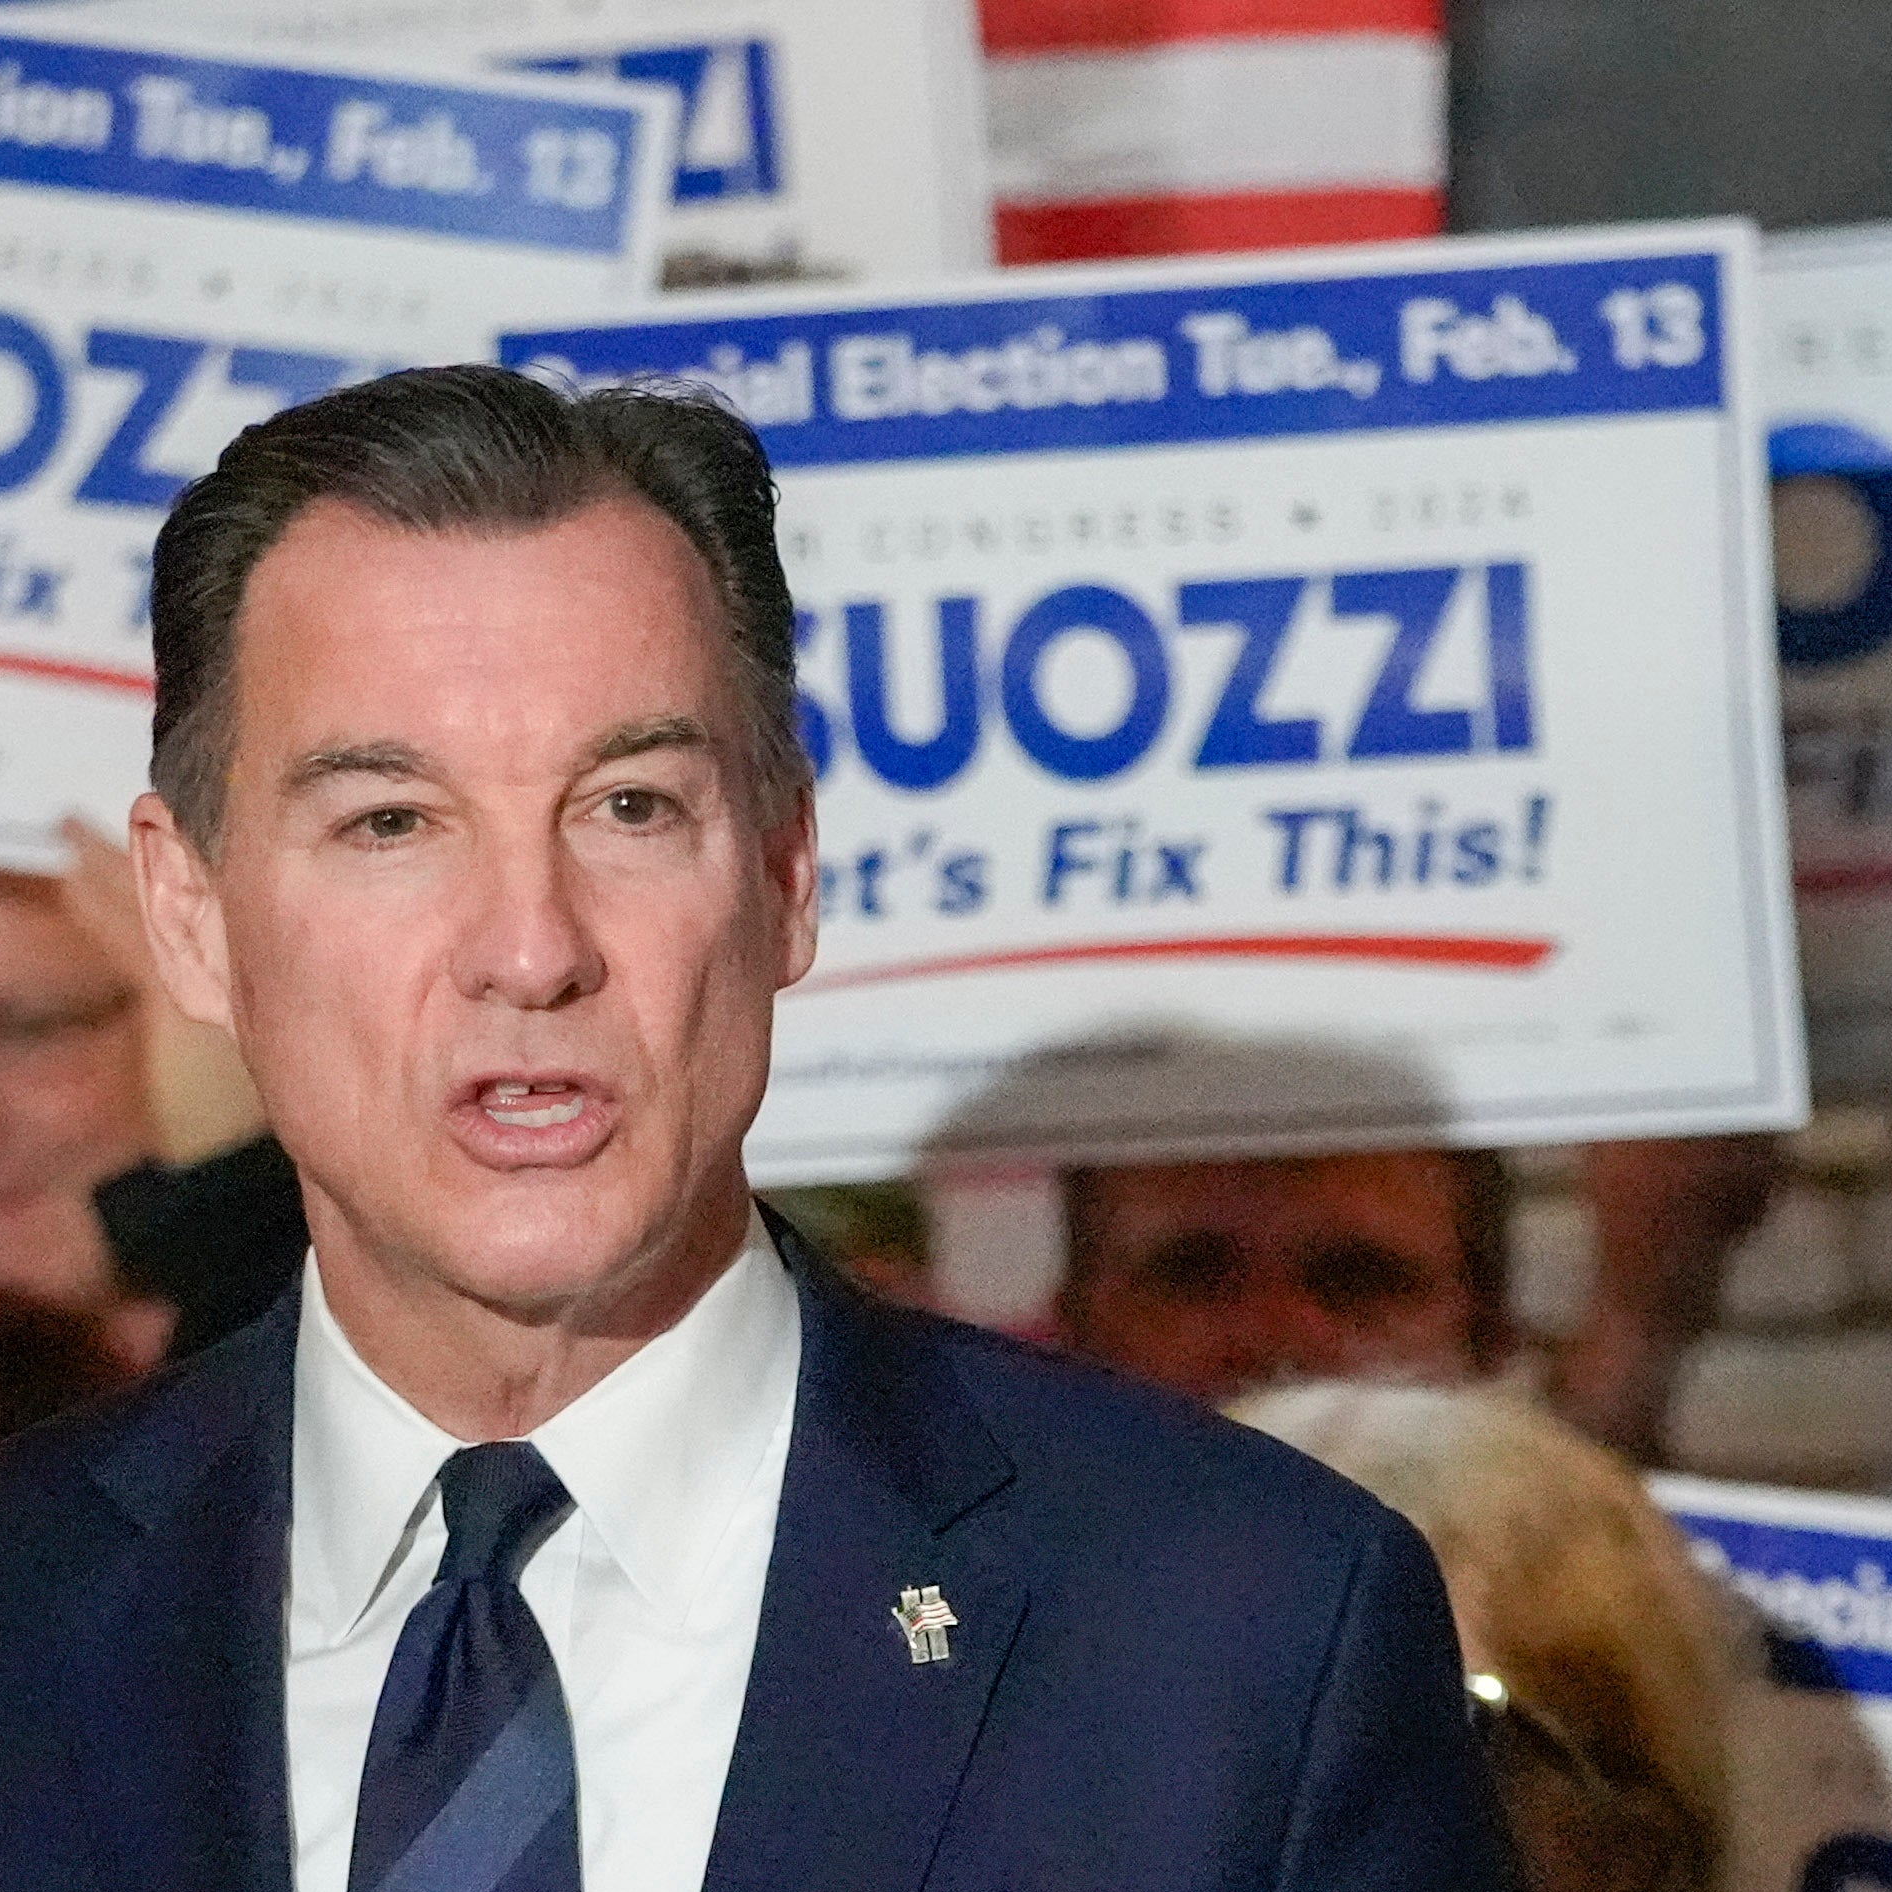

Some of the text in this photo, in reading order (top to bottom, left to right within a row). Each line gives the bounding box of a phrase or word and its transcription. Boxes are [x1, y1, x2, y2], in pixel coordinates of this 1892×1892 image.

[831, 325, 1169, 420] Election
[1399, 294, 1578, 383] Feb.
[1602, 286, 1704, 370] 13
[1039, 812, 1206, 909] Fix
[1260, 792, 1552, 895] This!
